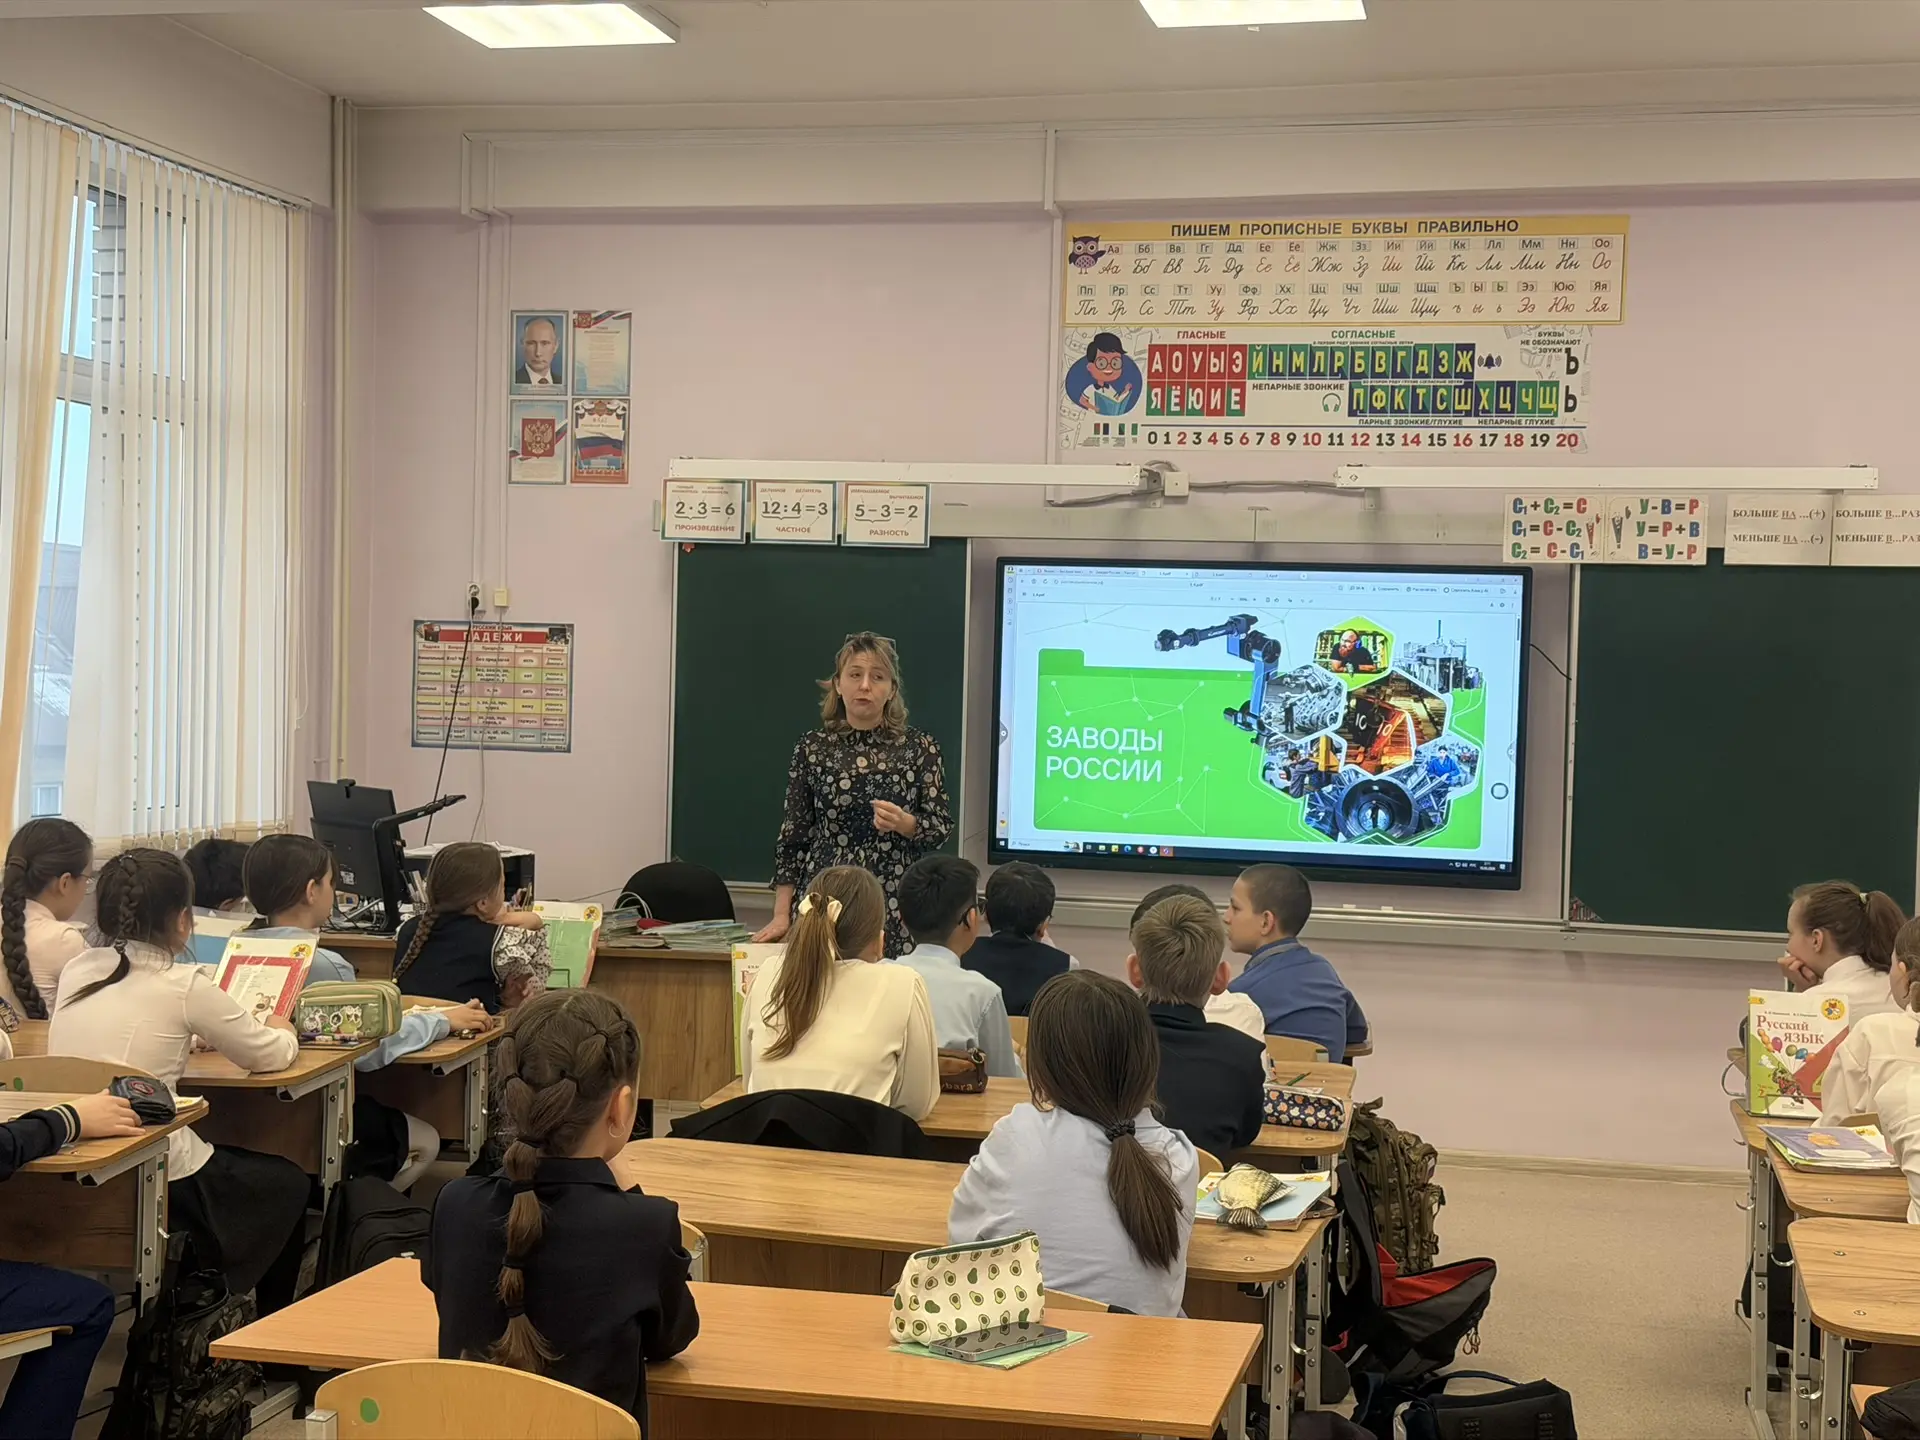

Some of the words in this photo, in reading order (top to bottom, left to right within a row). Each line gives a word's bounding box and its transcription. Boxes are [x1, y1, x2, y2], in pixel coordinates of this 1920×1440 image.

[1171, 224, 1230, 237] ПИШЕМ
[1239, 223, 1342, 236] ПРОПИСНЫЕ
[1351, 222, 1408, 235] БУКВЫ
[1417, 220, 1519, 234] ПРАВИЛЬНО
[1177, 330, 1226, 339] ГЛАСНЫЕ
[1331, 329, 1396, 339] СОГЛАСНЫЕ
[1151, 351, 1163, 373] А
[1172, 350, 1183, 373] О
[1191, 351, 1204, 373] У
[1209, 351, 1225, 373] Ы
[1231, 350, 1243, 373] Э
[1272, 350, 1284, 373] Н
[1292, 350, 1305, 373] М
[1312, 350, 1325, 373] Л
[1333, 350, 1345, 373] Р
[1353, 350, 1365, 373] Б
[1374, 350, 1386, 373] В
[1396, 350, 1407, 373] Г
[1415, 349, 1429, 374] Д
[1438, 350, 1449, 374] З
[1455, 350, 1474, 373] Ж
[1252, 383, 1301, 391] НЕПАРНЫЕ
[1303, 383, 1345, 391] ЗВОНКИЕ
[1150, 387, 1162, 409] Я
[1170, 385, 1181, 411] Ё
[1187, 387, 1204, 410] Ю
[1210, 387, 1222, 410] И
[1230, 388, 1241, 410] Е
[1352, 388, 1365, 410] П
[1372, 388, 1386, 410] Ф
[1394, 388, 1406, 410] К
[1416, 388, 1427, 411] Т
[1436, 388, 1448, 411] С
[1454, 388, 1472, 410] Ш
[1478, 387, 1490, 410] Х
[1498, 386, 1511, 412] Ц
[1521, 387, 1533, 410] Ч
[1538, 386, 1557, 412] Щ
[1358, 418, 1393, 426] ПАРНЫЕ
[1478, 418, 1523, 426] НЕПАРНЫЕ
[1524, 418, 1555, 426] ГЛУХИЕ
[1147, 431, 1158, 445] 0
[1163, 431, 1171, 445] 1
[1177, 431, 1187, 445] 2
[1192, 431, 1202, 445] 3
[1207, 432, 1218, 445] 4
[1223, 432, 1234, 445] 5
[1239, 432, 1250, 446] 6
[1255, 432, 1265, 446] 7
[1270, 432, 1281, 446] 8
[1286, 432, 1297, 446] 9
[1302, 432, 1322, 446] 10
[1327, 432, 1345, 446] 11
[1350, 432, 1370, 447] 12
[1375, 432, 1395, 447] 13
[1401, 432, 1422, 447] 14
[1427, 432, 1447, 447] 15
[1453, 432, 1473, 447] 16
[1479, 432, 1498, 447] 17
[1504, 432, 1524, 447] 18
[1530, 433, 1550, 447] 19
[1556, 433, 1579, 447] 20
[1732, 509, 1779, 518] БОЛЬШЕ
[1781, 510, 1796, 520] НА
[1835, 509, 1882, 518] БОЛЬШЕ
[674, 524, 736, 532] ПРОИЗВЕДЕНИЕ
[775, 526, 811, 534] ЧАСТНОЕ
[869, 529, 909, 537] РАЗНОСТЬ
[1732, 534, 1781, 543] МЕНЬШЕ
[1783, 535, 1798, 544] НА
[1835, 534, 1884, 543] МЕНЬШЕ
[1046, 725, 1163, 754] ЗАВОДЫ
[1046, 755, 1163, 782] РОССИИ
[1756, 1014, 1809, 1032] Русский
